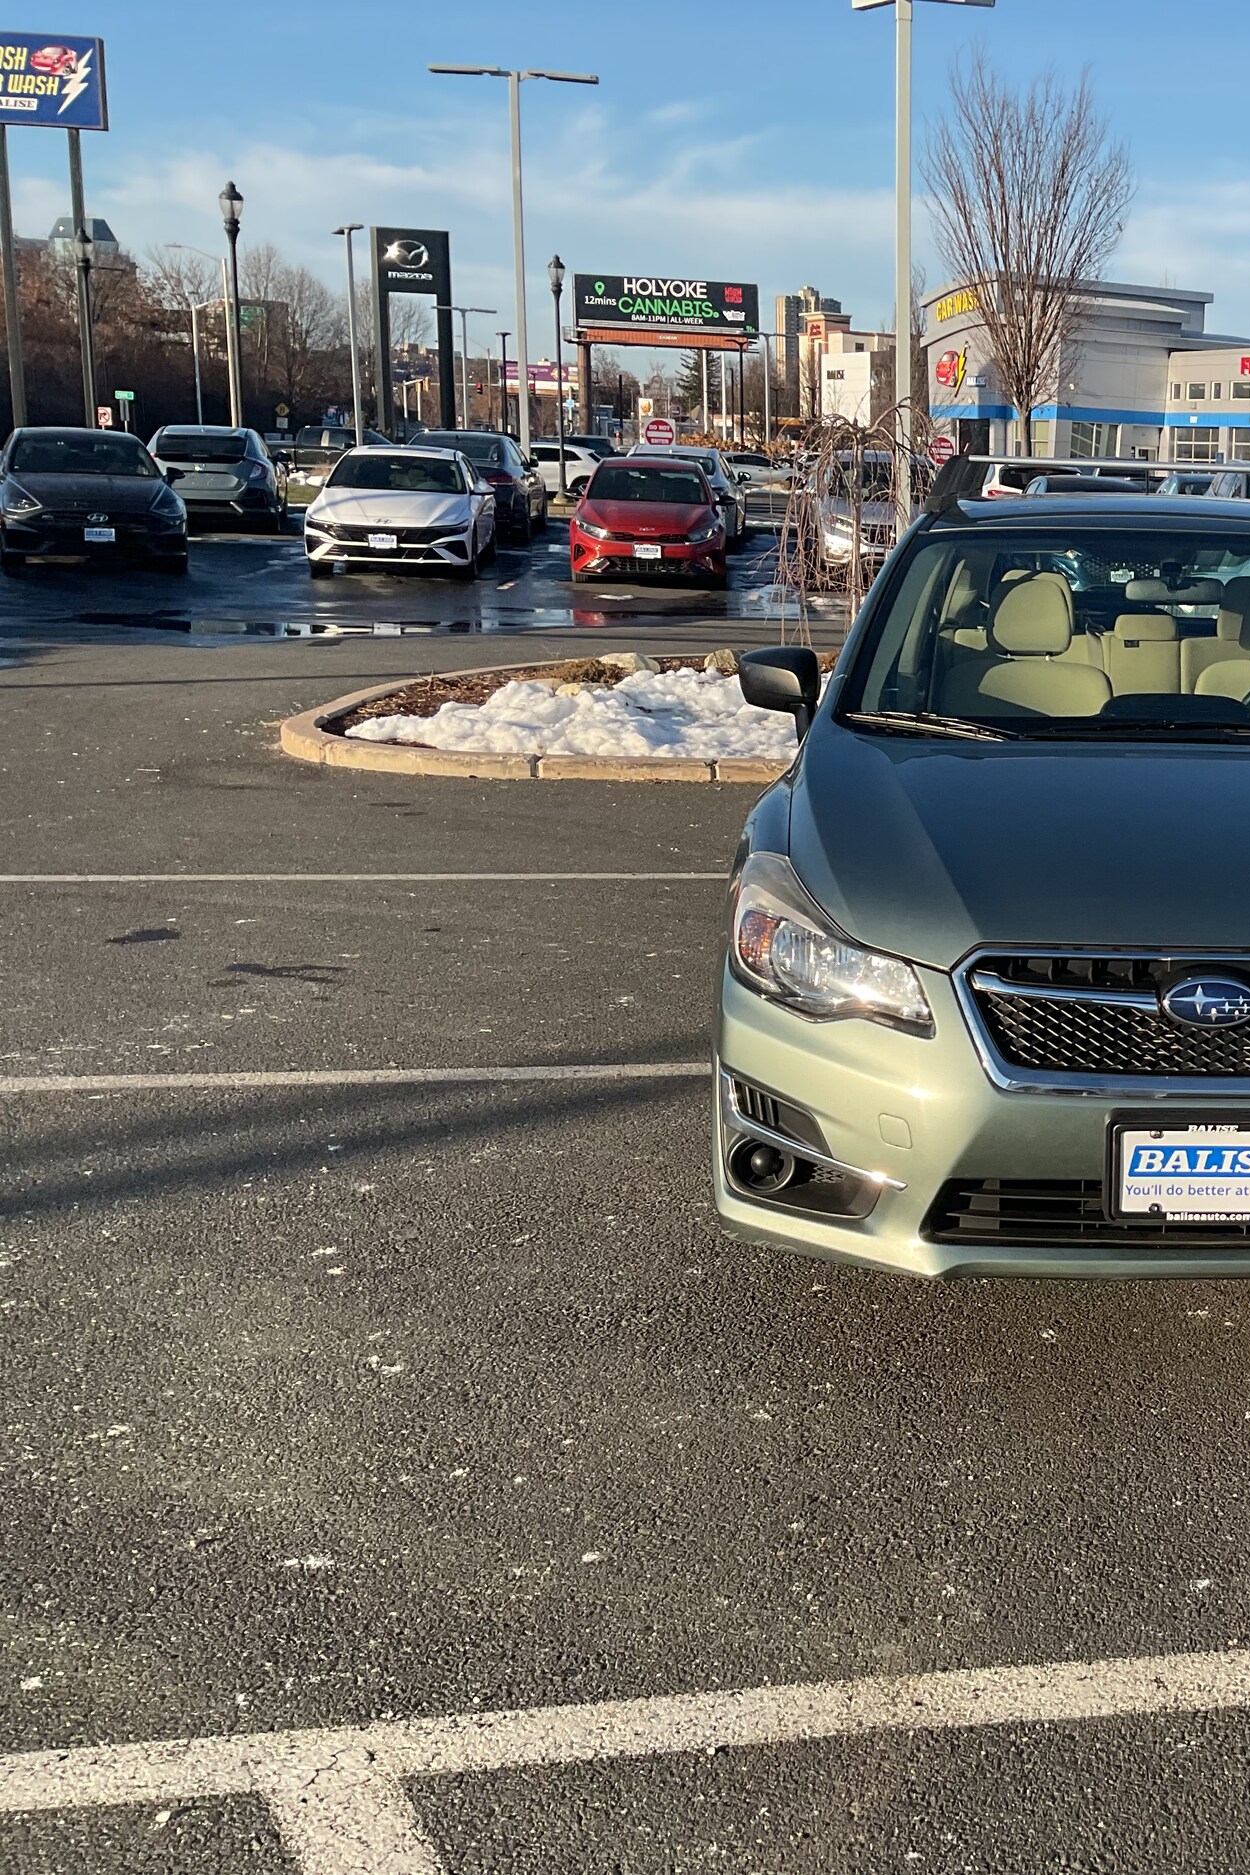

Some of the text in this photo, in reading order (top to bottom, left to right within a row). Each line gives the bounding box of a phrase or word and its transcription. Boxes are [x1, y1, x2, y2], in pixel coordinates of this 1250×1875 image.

[8, 74, 60, 96] WASH
[623, 277, 708, 299] HOLYOKE
[584, 295, 617, 306] 12mins
[936, 297, 953, 321] CAR
[631, 314, 666, 323] 8AM-11PM
[670, 317, 704, 325] ALL-WEEK
[1188, 1124, 1239, 1133] BALISE
[1125, 1184, 1162, 1196] You'll
[1166, 1184, 1184, 1196] do
[1188, 1184, 1230, 1196] better
[1235, 1185, 1250, 1196] at
